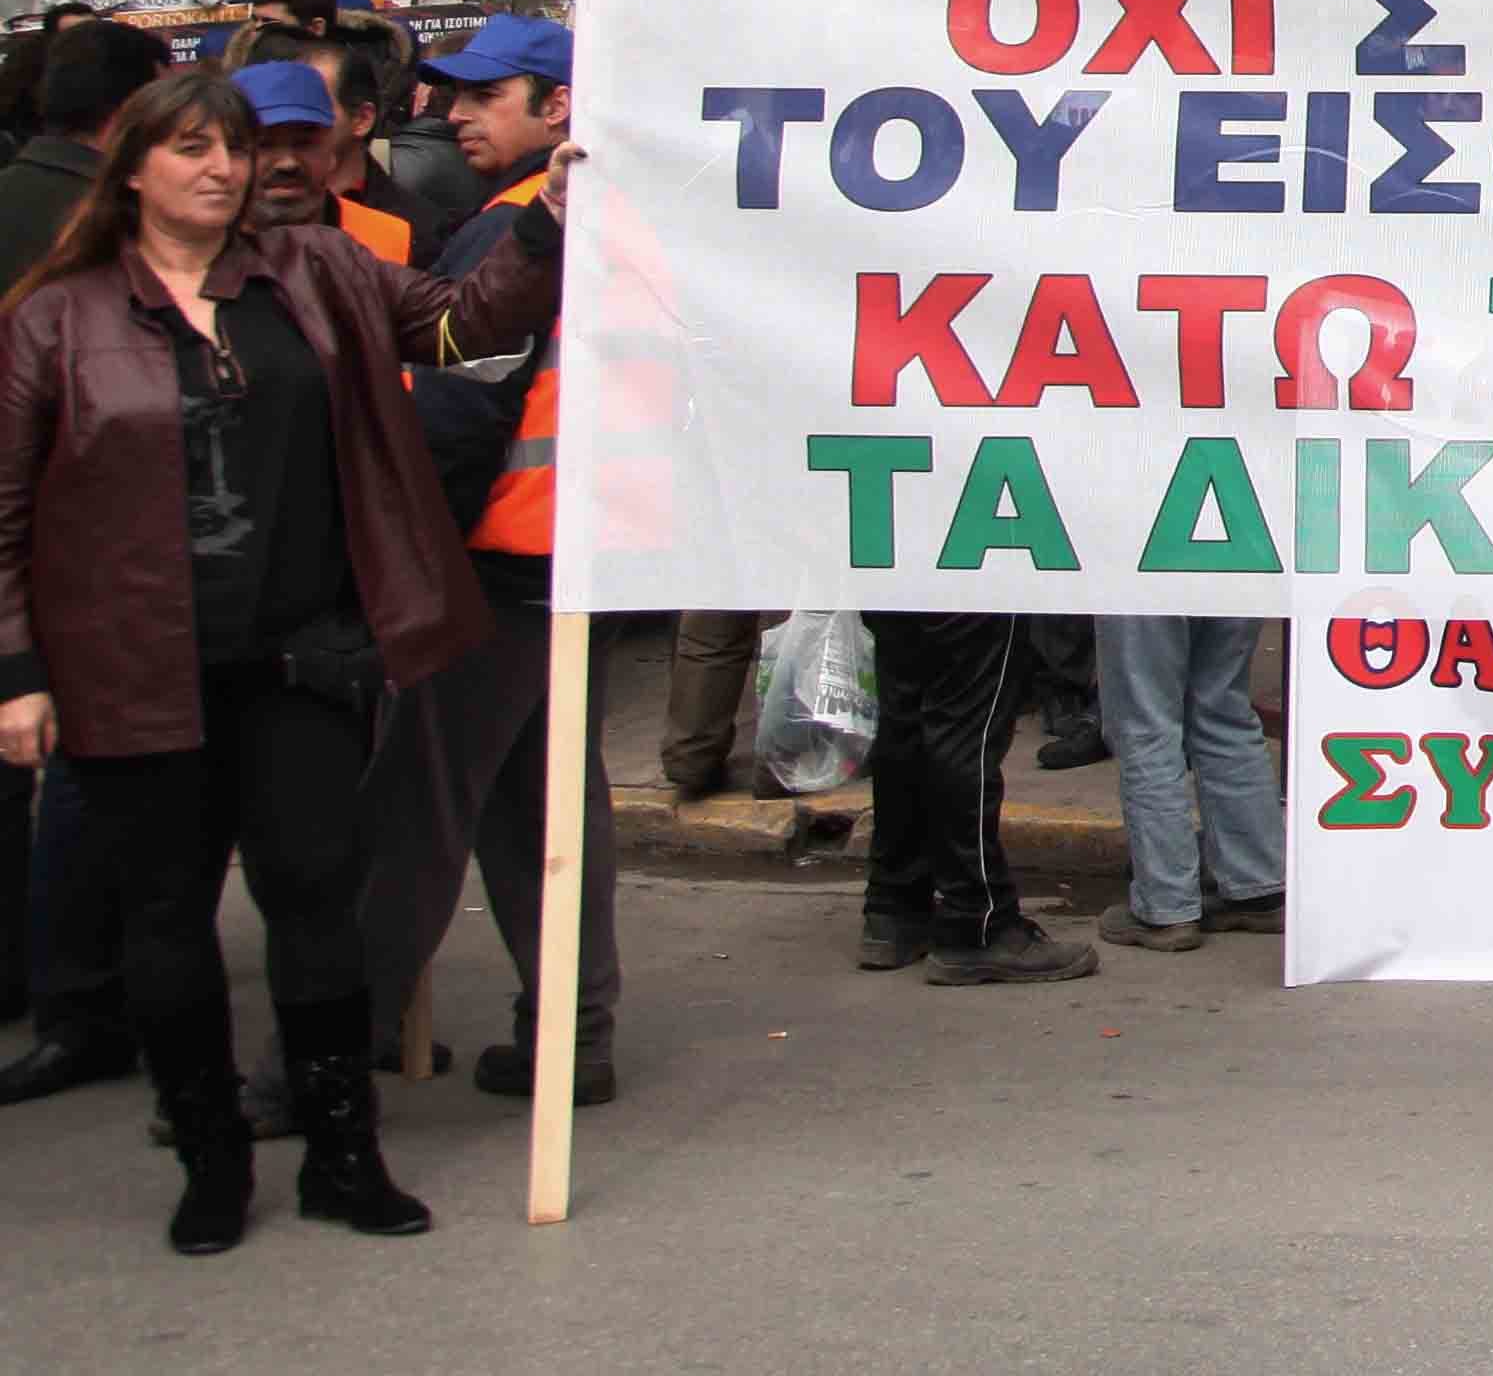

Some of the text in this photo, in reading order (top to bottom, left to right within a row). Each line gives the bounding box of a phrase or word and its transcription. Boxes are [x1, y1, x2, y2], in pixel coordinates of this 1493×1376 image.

[701, 88, 1112, 212] ΤΟΥ
[851, 273, 1417, 411] ΚΑΤΩ
[807, 435, 1082, 571] ΤΑ
